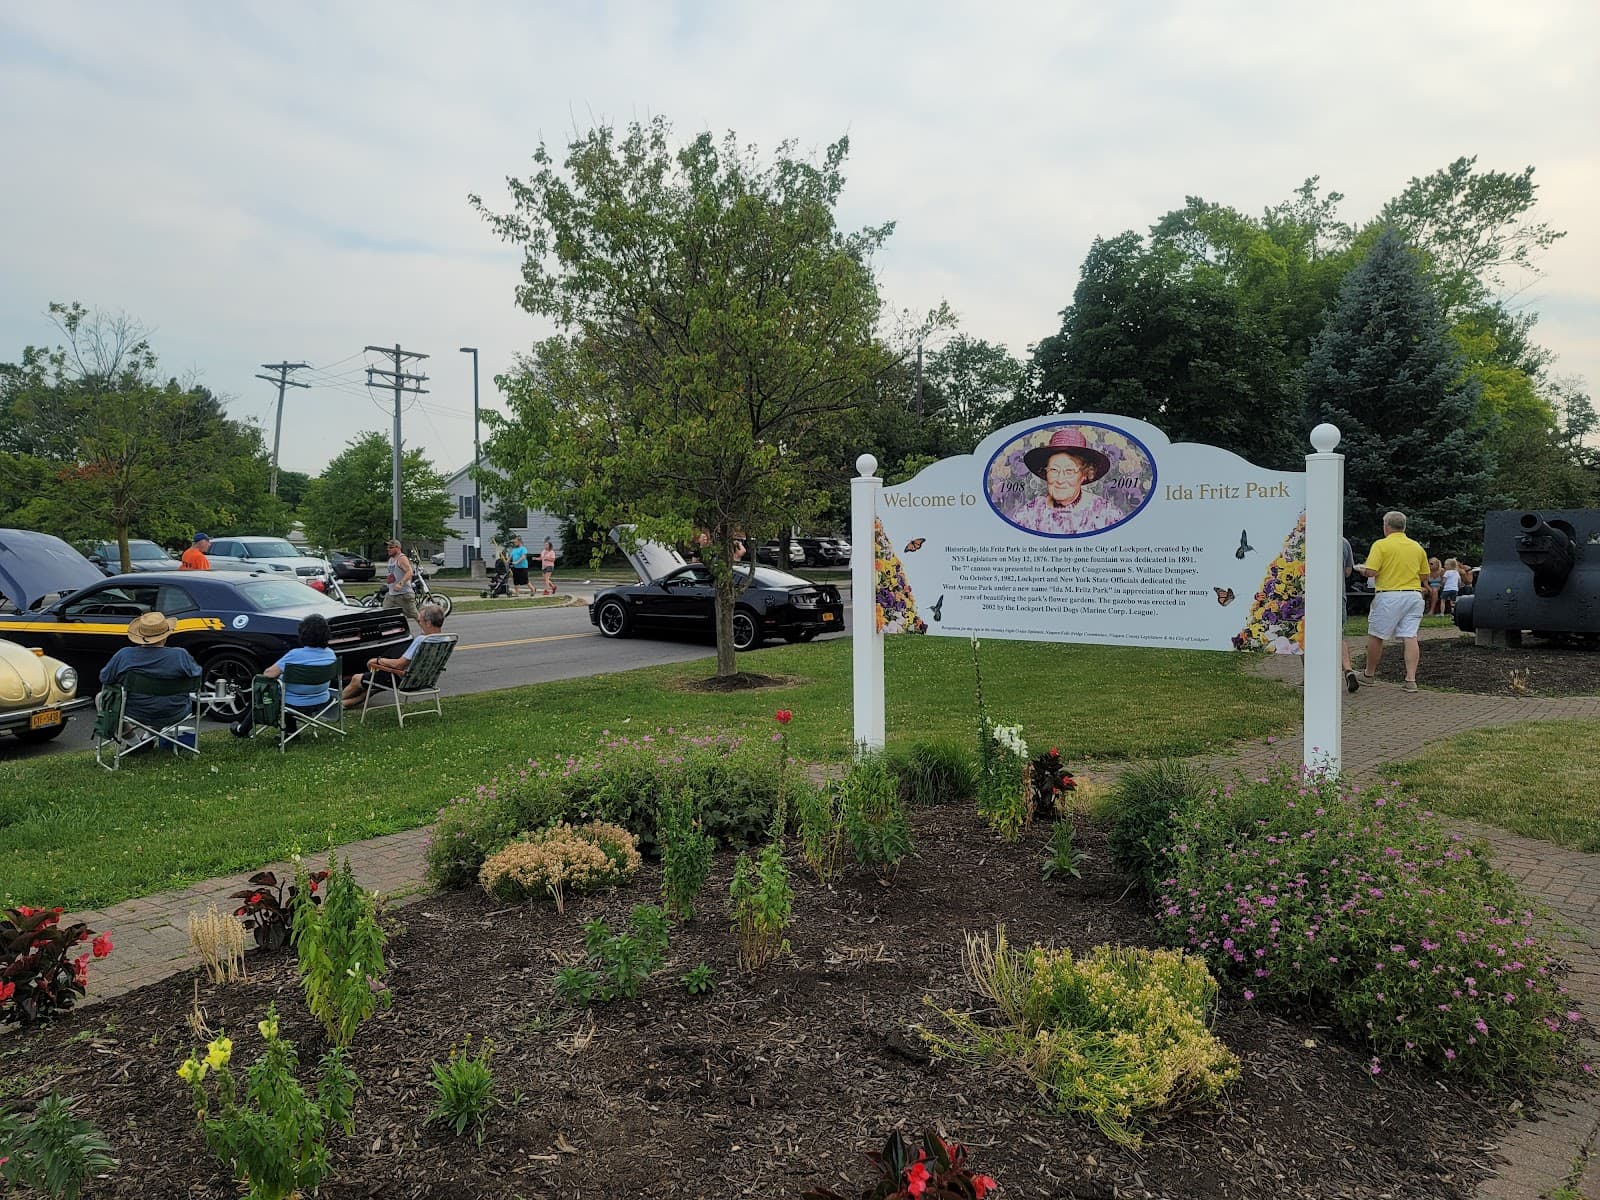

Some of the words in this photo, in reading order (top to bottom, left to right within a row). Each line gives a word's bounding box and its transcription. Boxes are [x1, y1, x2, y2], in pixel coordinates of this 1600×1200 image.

[1000, 482, 1025, 493] 1908
[1110, 477, 1139, 490] 2001
[1166, 484, 1192, 500] Ida
[1197, 483, 1240, 499] Fritz
[1246, 481, 1291, 498] Park
[884, 492, 956, 507] Welcome
[960, 492, 976, 506] to
[1058, 546, 1074, 554] park
[1095, 546, 1109, 554] City
[1119, 546, 1153, 554] Lockport,
[1181, 546, 1191, 554] by
[1008, 555, 1021, 563] May
[1005, 565, 1033, 574] presented
[1042, 566, 1071, 574] Lockport
[1072, 566, 1080, 574] by
[1082, 566, 1126, 574] Congressman
[1164, 567, 1199, 575] Dempsey.
[1017, 575, 1045, 583] Lockport
[1122, 587, 1165, 596] appreciation
[984, 594, 1016, 602] beautifying
[1069, 596, 1096, 604] gardens.
[1112, 597, 1136, 605] gazebo
[997, 604, 1004, 612] by
[1016, 604, 1044, 613] Lockport
[1063, 606, 1079, 614] Dogs
